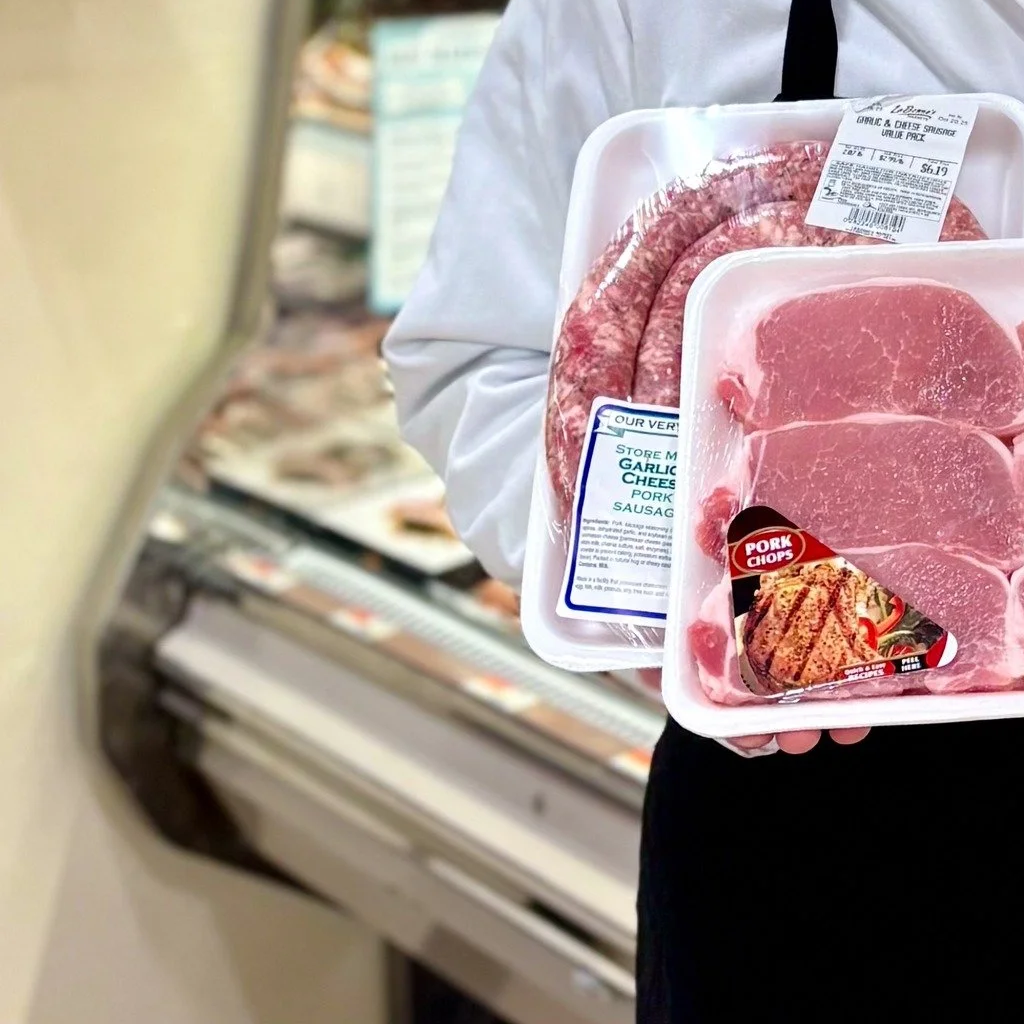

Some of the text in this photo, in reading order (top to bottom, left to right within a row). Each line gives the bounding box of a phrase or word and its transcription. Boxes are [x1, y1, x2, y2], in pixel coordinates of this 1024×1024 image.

[856, 116, 957, 137] GARLIC & CHEESE SAUSAGE
[881, 129, 926, 142] VALUE PACK
[920, 163, 948, 176] $6.19
[615, 415, 645, 428] OUR
[615, 444, 662, 459] STORE
[619, 458, 677, 476] GARLIC
[631, 489, 673, 503] PORK
[745, 533, 793, 556] PORK
[746, 548, 794, 568] CHOPS
